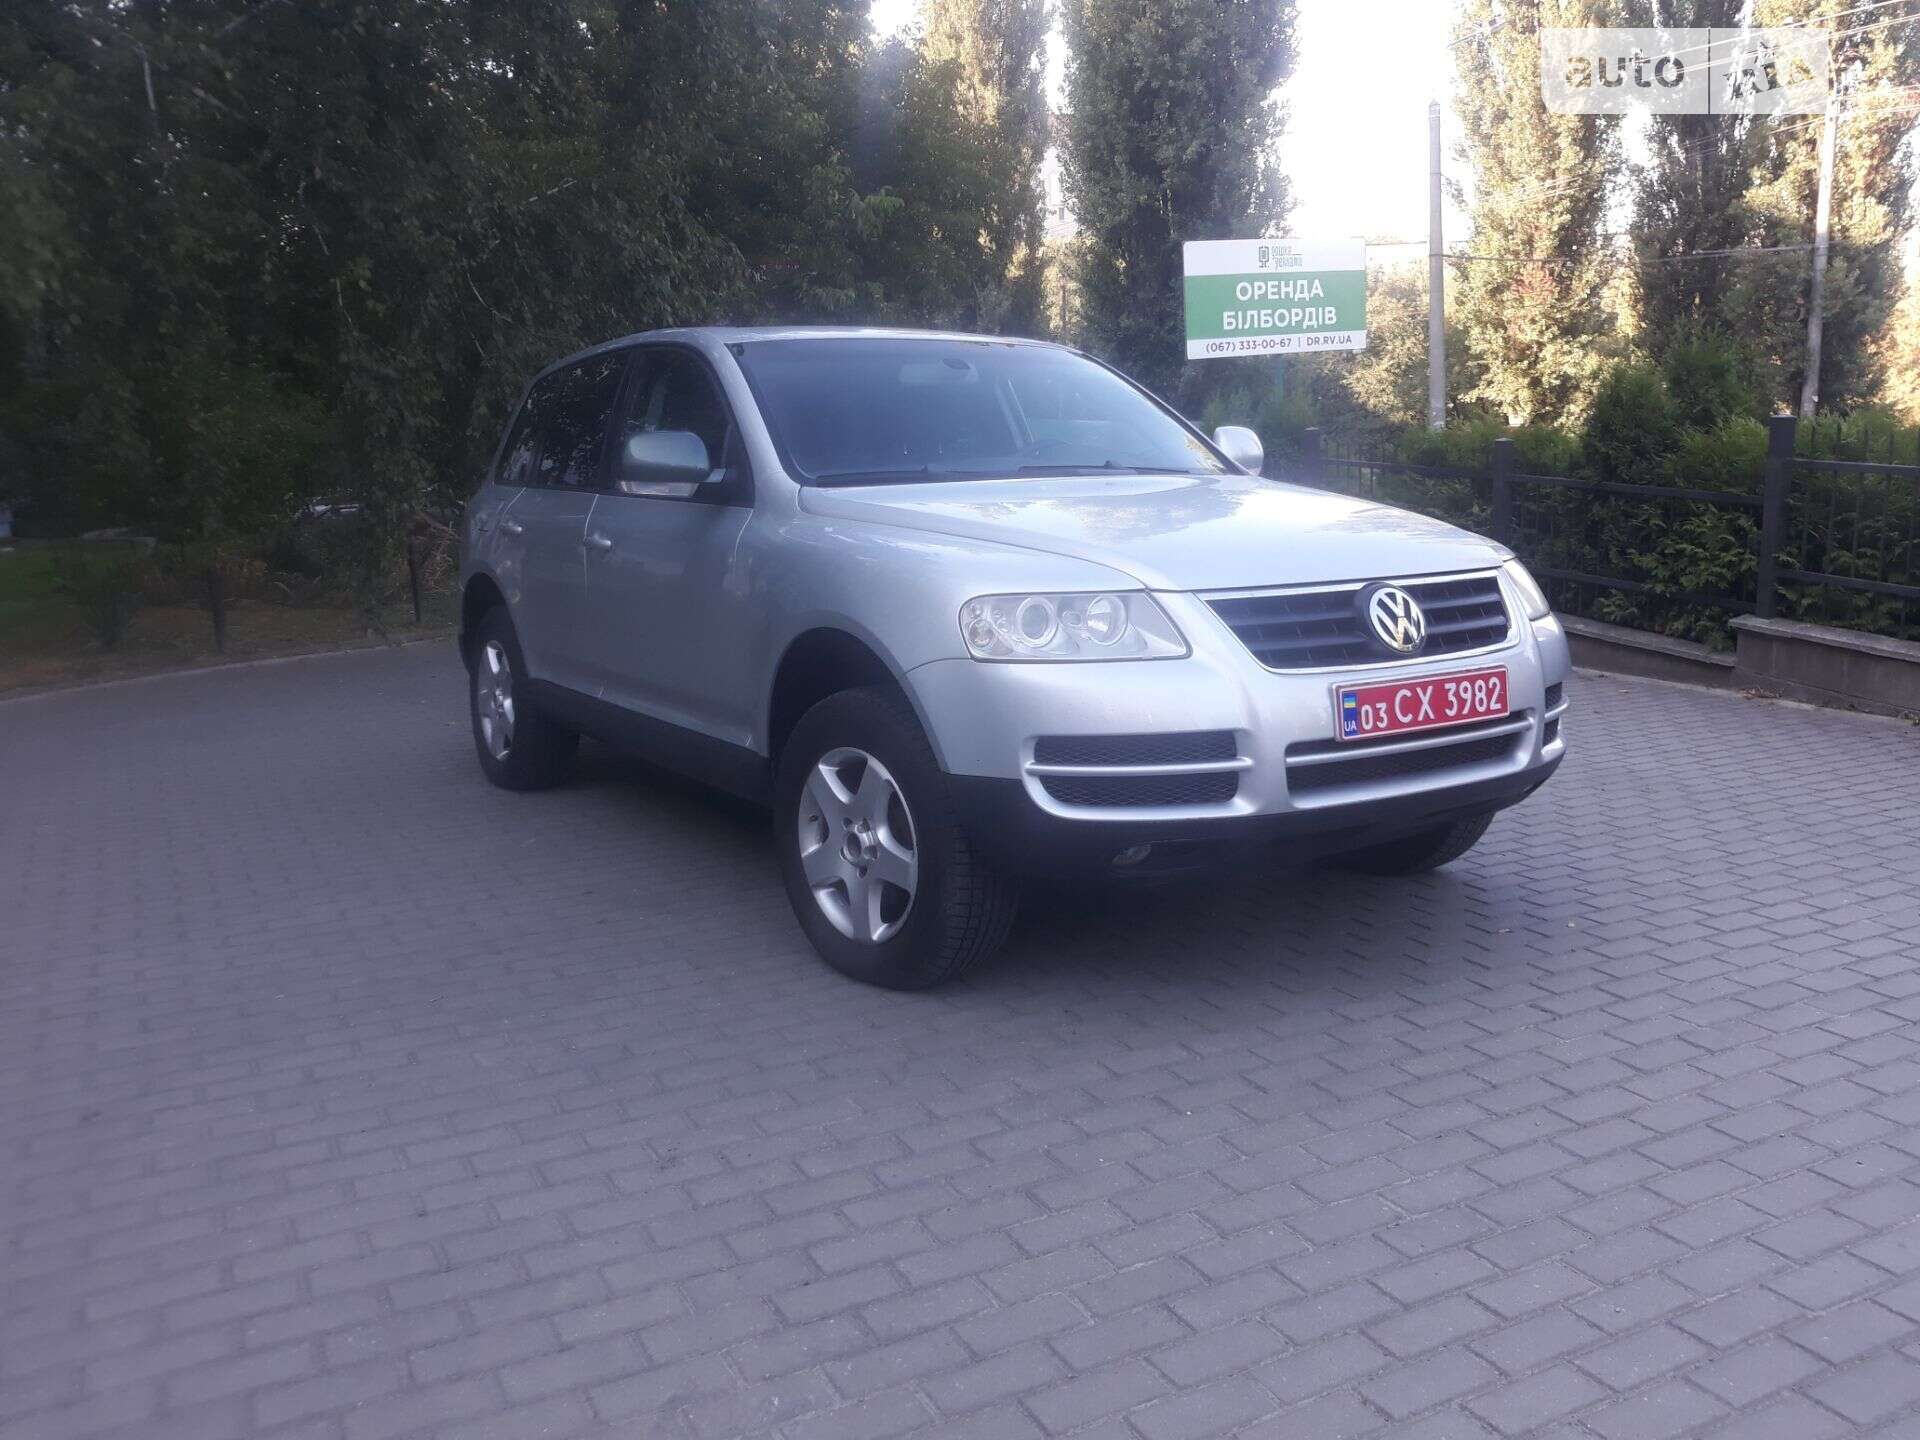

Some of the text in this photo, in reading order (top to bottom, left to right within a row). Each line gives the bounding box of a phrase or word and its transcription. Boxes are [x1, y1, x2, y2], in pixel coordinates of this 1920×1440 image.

[1236, 279, 1324, 302] ОРЕНДА
[1223, 306, 1337, 330] БІЛБОРДІВ
[1205, 334, 1352, 354] (067) 333-00-67 DR.RV.UA
[1360, 676, 1502, 730] 03 CX 3982
[1344, 719, 1357, 732] UA
